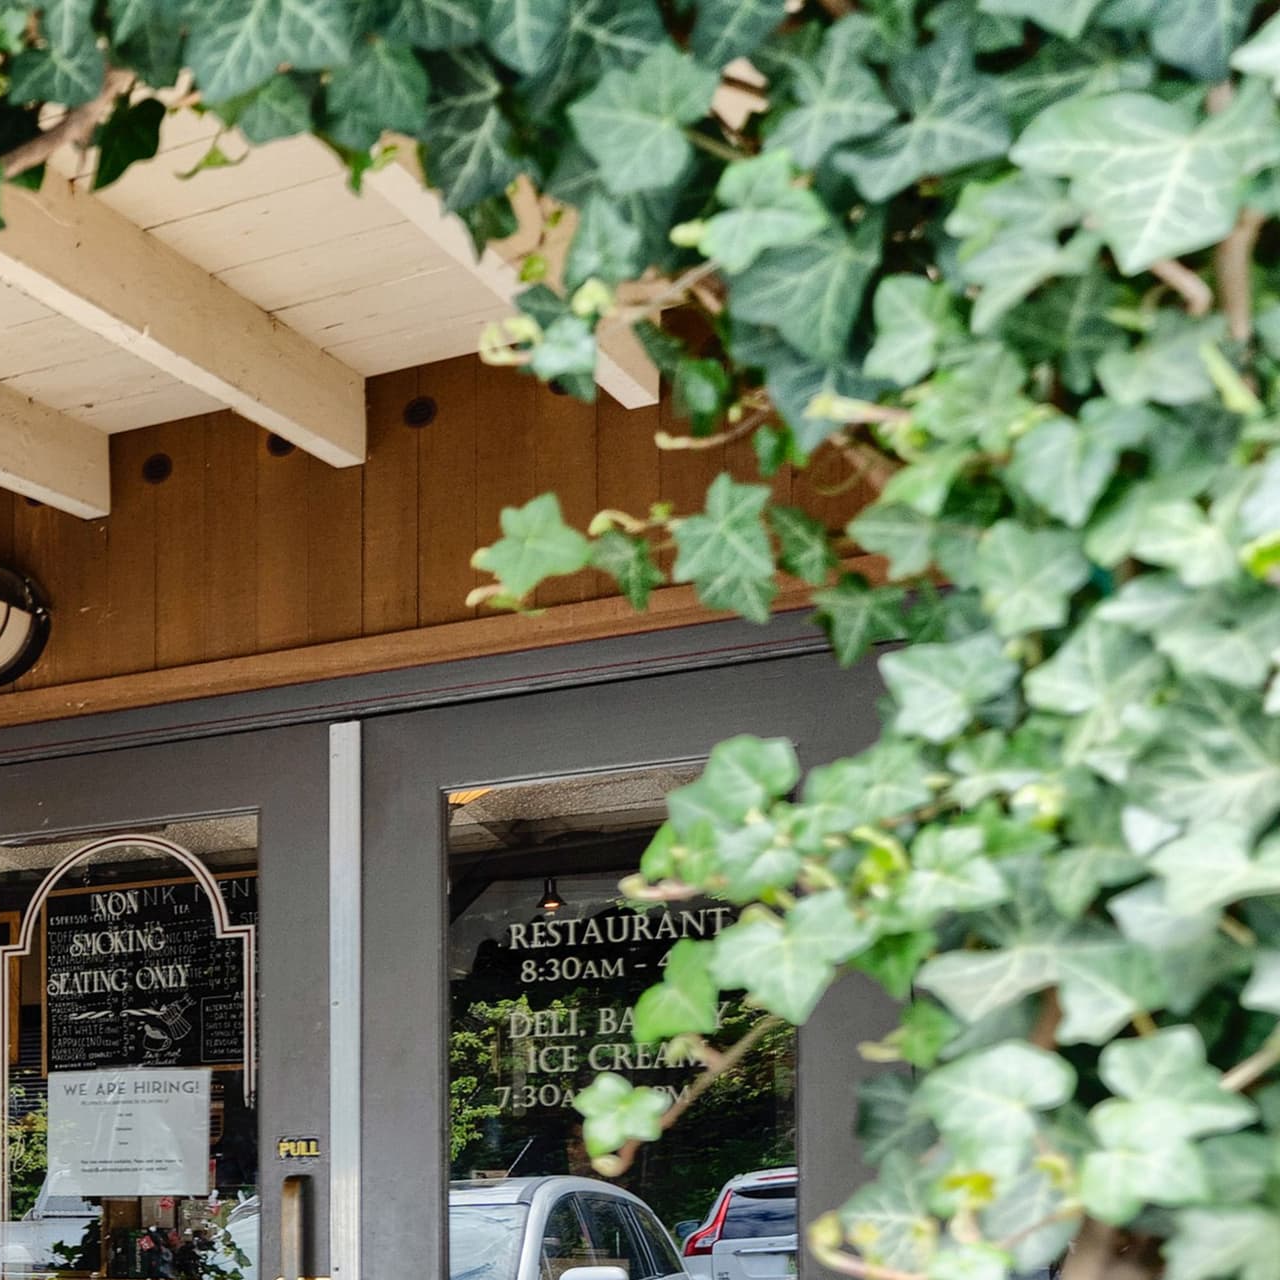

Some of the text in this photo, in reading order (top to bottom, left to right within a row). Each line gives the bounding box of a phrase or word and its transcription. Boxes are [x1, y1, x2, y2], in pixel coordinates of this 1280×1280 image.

[94, 889, 139, 922] NON
[70, 927, 165, 957] SMOKING
[509, 908, 730, 950] RESTAURANT
[47, 968, 128, 995] SEATING
[136, 964, 191, 990] ONLY
[520, 958, 624, 983] 8:30AM
[74, 1023, 104, 1036] WHITE
[508, 1009, 588, 1040] DELI,
[530, 1046, 580, 1074] ICE
[63, 1080, 200, 1096] WE ARE HIRING!
[491, 1083, 586, 1109] 7:30A
[279, 1140, 321, 1158] PULL
